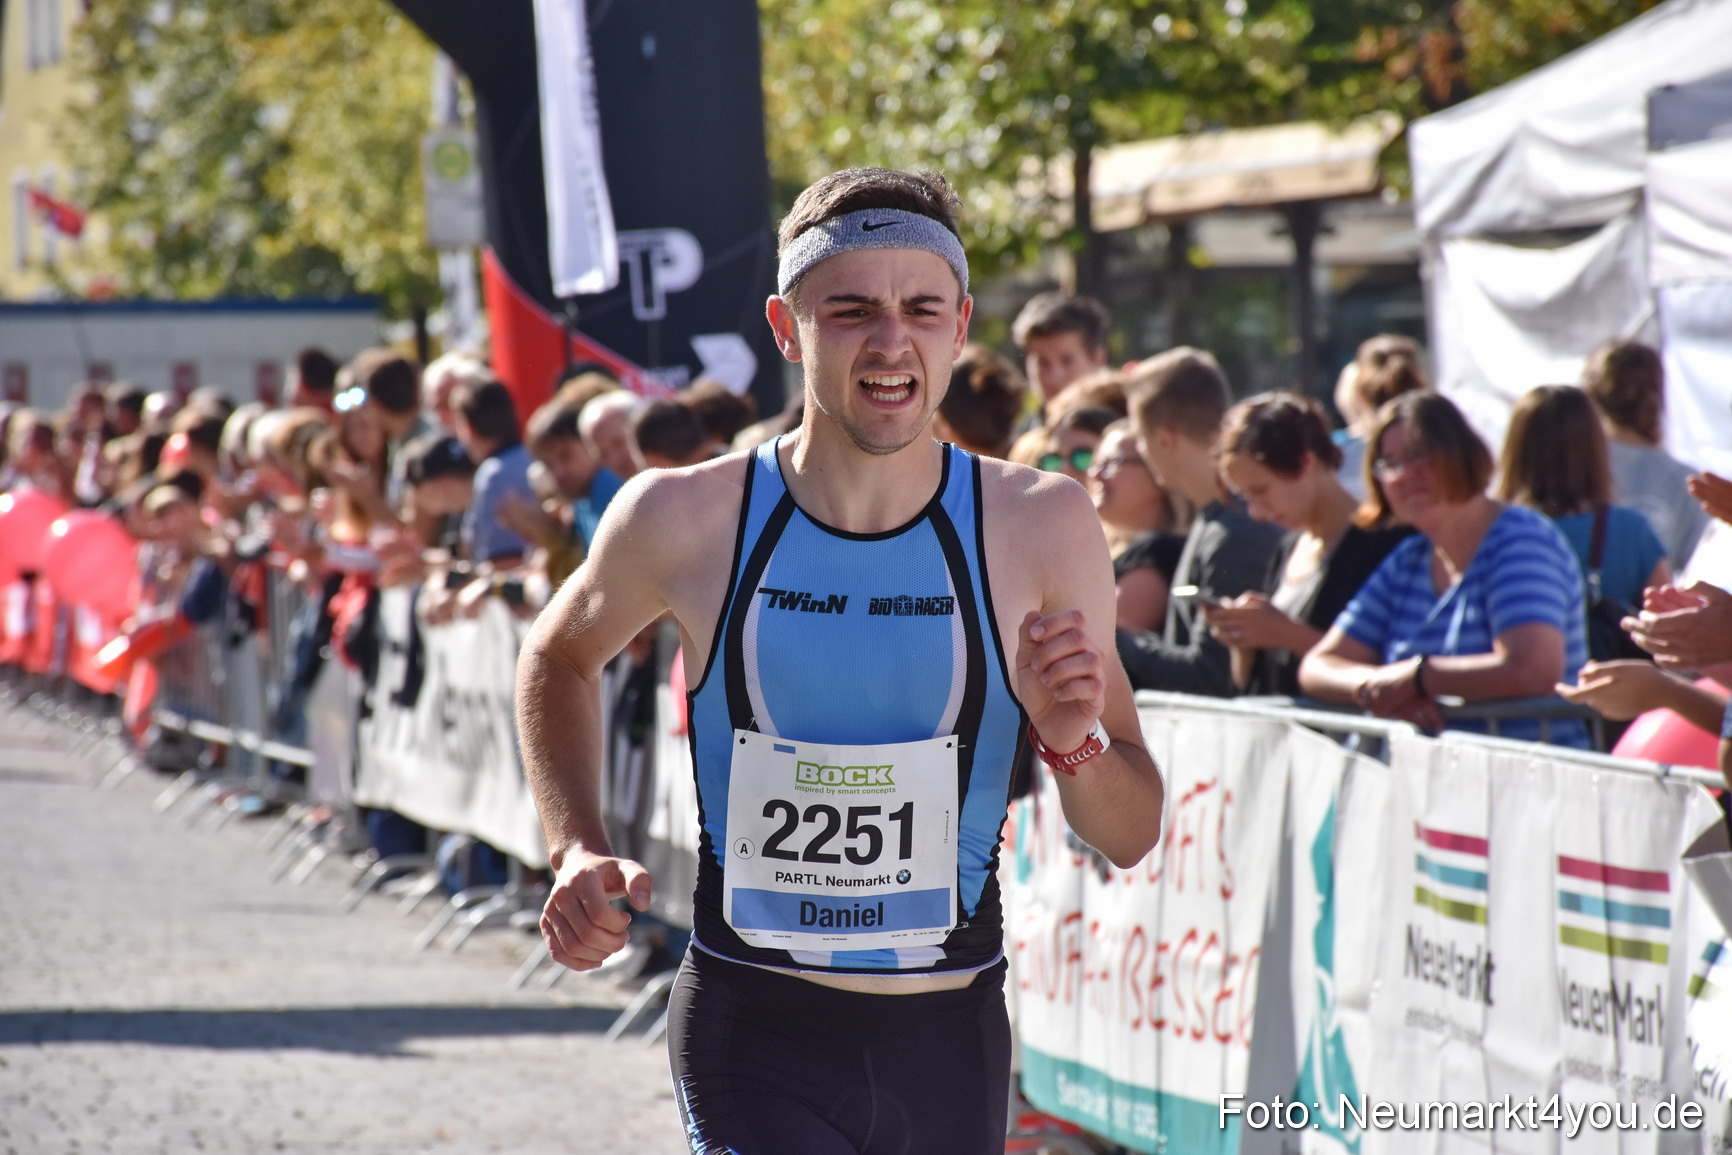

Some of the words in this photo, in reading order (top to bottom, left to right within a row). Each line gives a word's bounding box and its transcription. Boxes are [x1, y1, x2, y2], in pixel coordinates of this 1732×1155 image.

[796, 760, 895, 787] BOCK
[795, 784, 825, 794] inspired
[826, 786, 836, 796] by
[862, 786, 896, 795] concepts
[761, 799, 914, 866] 2251
[739, 843, 749, 855] A
[775, 871, 823, 886] PARTL
[826, 874, 891, 887] Neumarkt
[800, 901, 883, 928] Daniel
